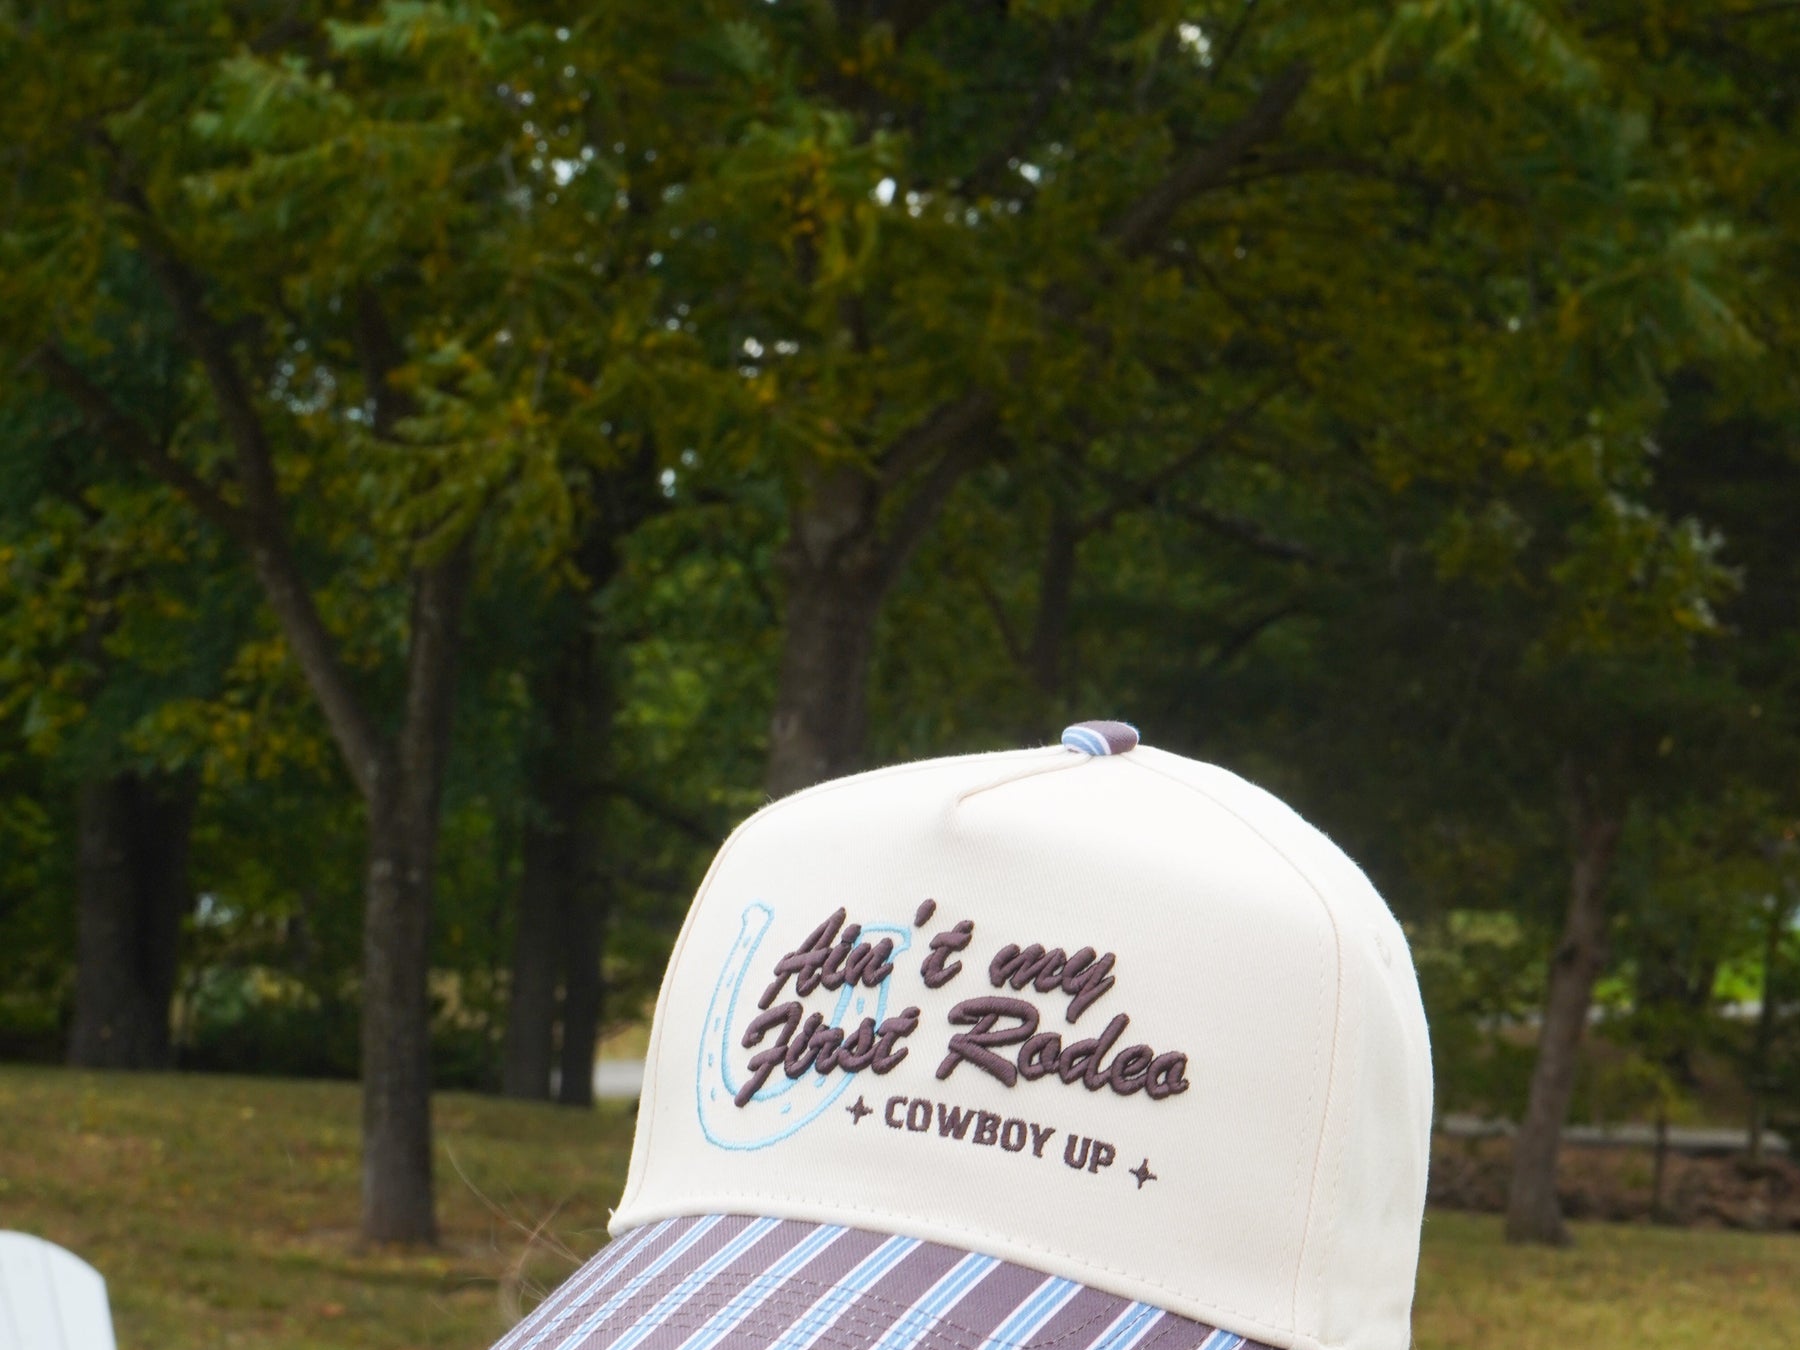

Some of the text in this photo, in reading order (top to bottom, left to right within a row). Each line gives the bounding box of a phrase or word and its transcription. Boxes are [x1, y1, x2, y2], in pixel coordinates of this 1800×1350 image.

[758, 898, 1116, 1024] Ain't my
[734, 996, 1190, 1108] First Rodeo
[884, 1096, 1116, 1174] COWBOY UP
